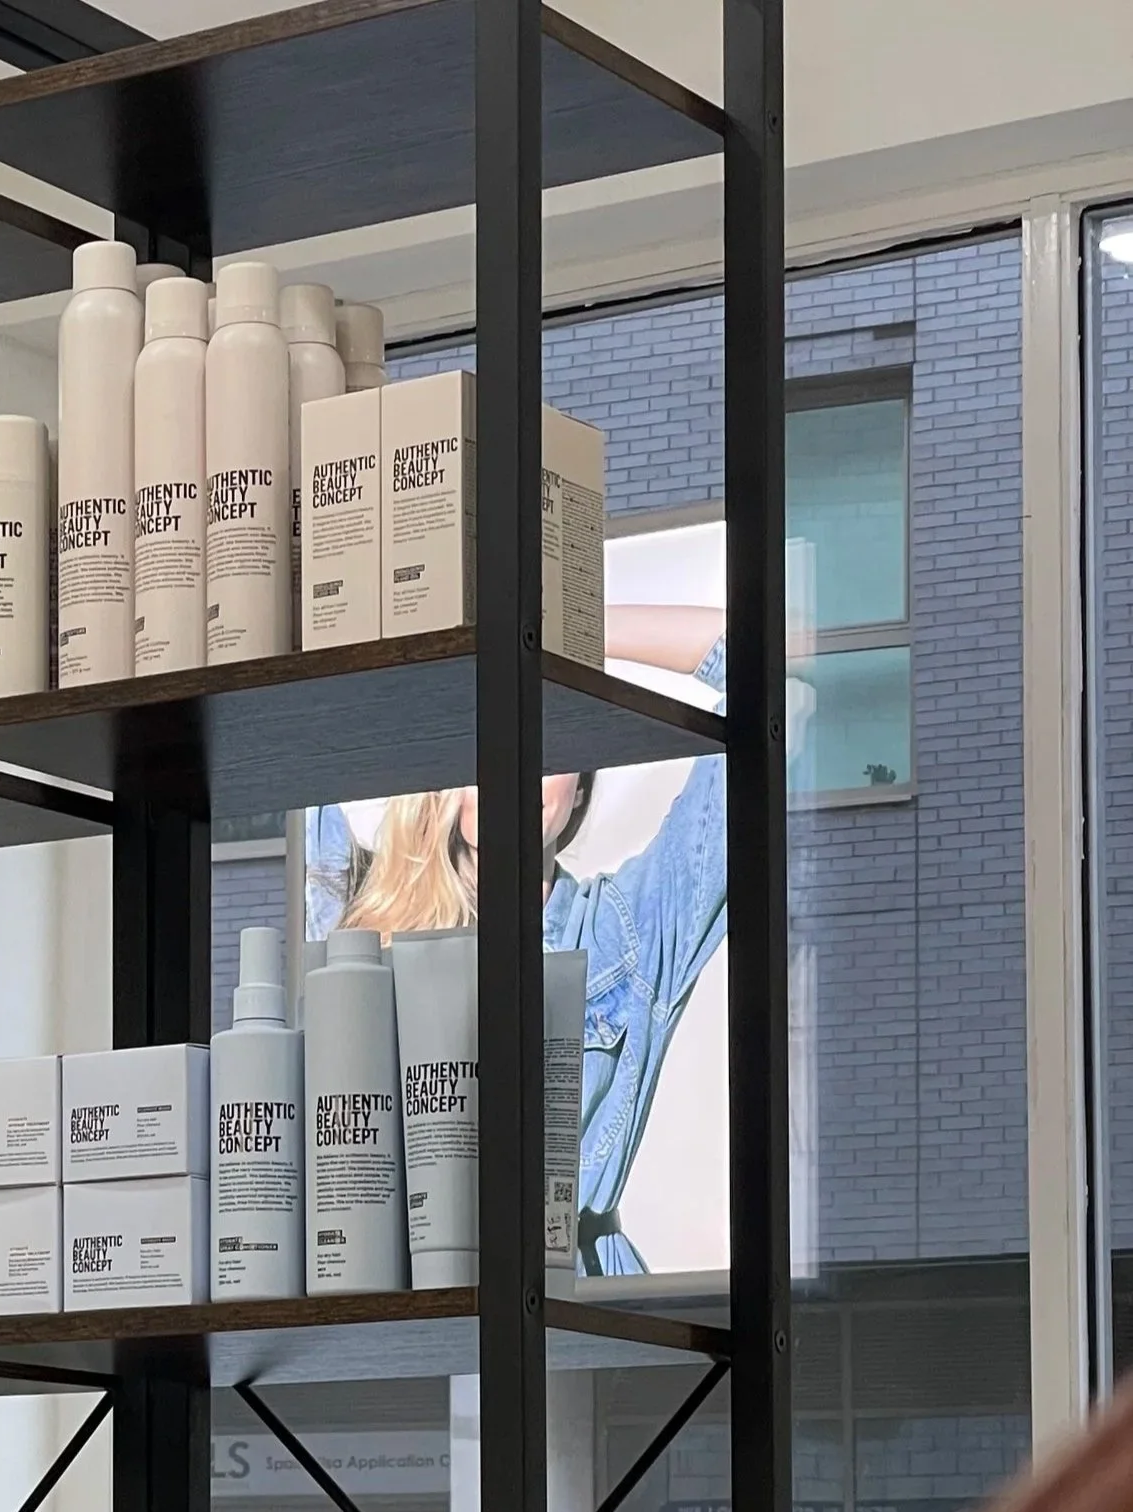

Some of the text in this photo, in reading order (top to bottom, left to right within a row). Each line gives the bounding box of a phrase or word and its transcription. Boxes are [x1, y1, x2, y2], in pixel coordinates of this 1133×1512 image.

[394, 437, 458, 463] AUTHENTIC
[313, 454, 376, 479] AUTHENTIC
[394, 457, 438, 477] BEAUTY
[313, 473, 356, 494] BEAUTY
[393, 469, 445, 492] CONCEPT
[313, 486, 363, 508] CONCEPT
[406, 1079, 458, 1099] BEAUTY
[71, 1104, 119, 1120] AUTHENTIC
[219, 1102, 295, 1121] AUTHENTIC
[317, 1094, 393, 1113] AUTHENTIC
[407, 1096, 467, 1117] CONCEPT
[71, 1119, 104, 1131] BEAUTY
[219, 1119, 272, 1137] BEAUTY
[317, 1112, 370, 1130] BEAUTY
[71, 1129, 110, 1143] CONCEPT
[219, 1135, 281, 1154] CONCEPT
[316, 1128, 379, 1147] CONCEPT
[73, 1235, 122, 1250] AUTHENTIC
[73, 1249, 108, 1261] BEAUTY
[73, 1260, 112, 1273] CONCEPT
[212, 1441, 250, 1479] LS
[347, 1453, 434, 1471] Application
